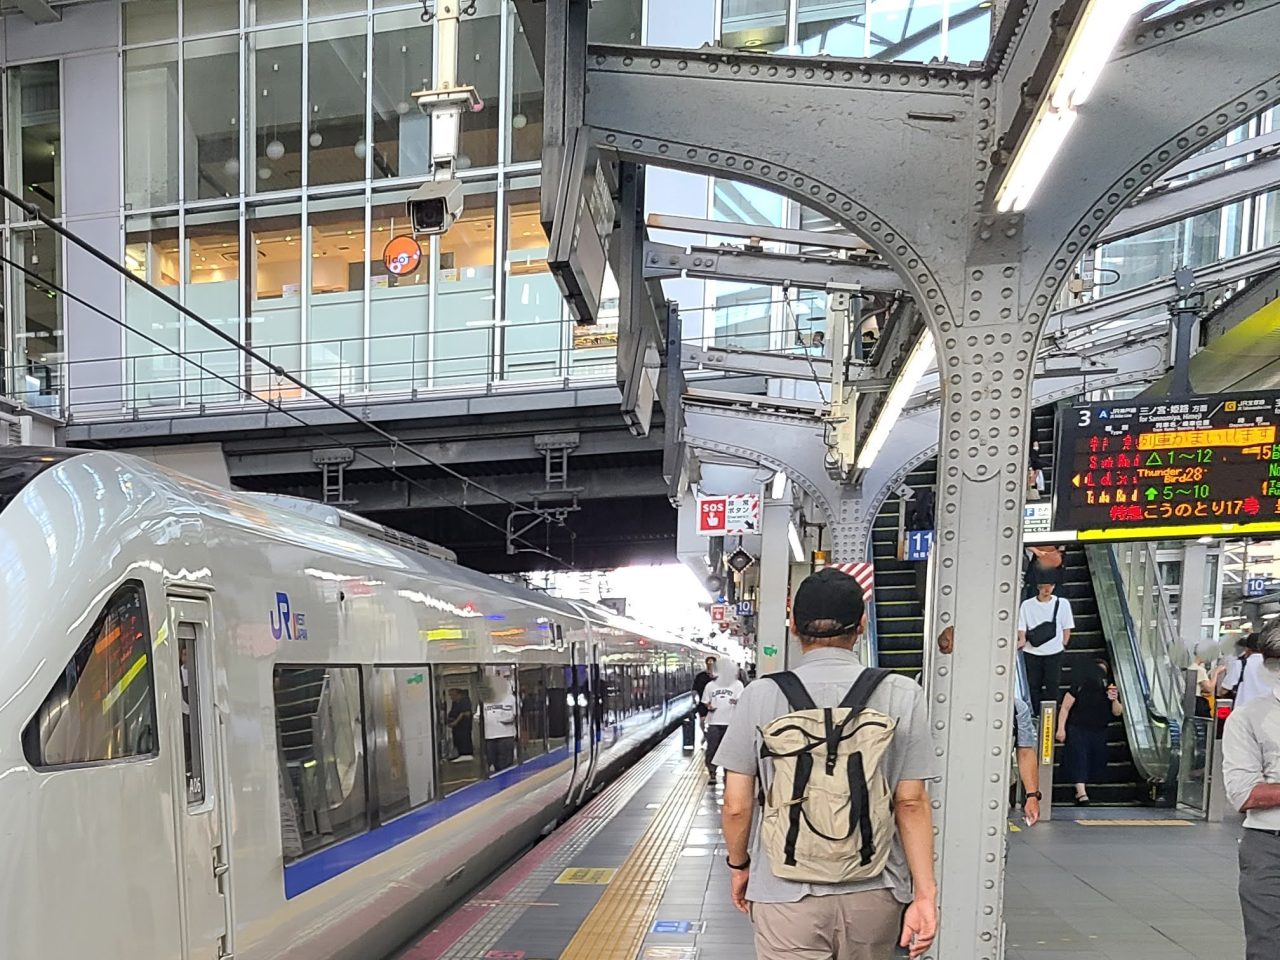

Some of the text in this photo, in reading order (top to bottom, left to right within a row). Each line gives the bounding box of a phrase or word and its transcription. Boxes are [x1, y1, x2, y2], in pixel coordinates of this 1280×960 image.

[1078, 410, 1091, 427] 3
[1098, 410, 1108, 419] A
[1138, 415, 1148, 423] for
[1182, 412, 1203, 421] Himeji
[1137, 467, 1183, 478] Thunder
[702, 503, 724, 512] SOS
[912, 532, 933, 551] 11
[1249, 579, 1265, 591] 10
[736, 601, 751, 611] 10
[269, 591, 292, 641] JR
